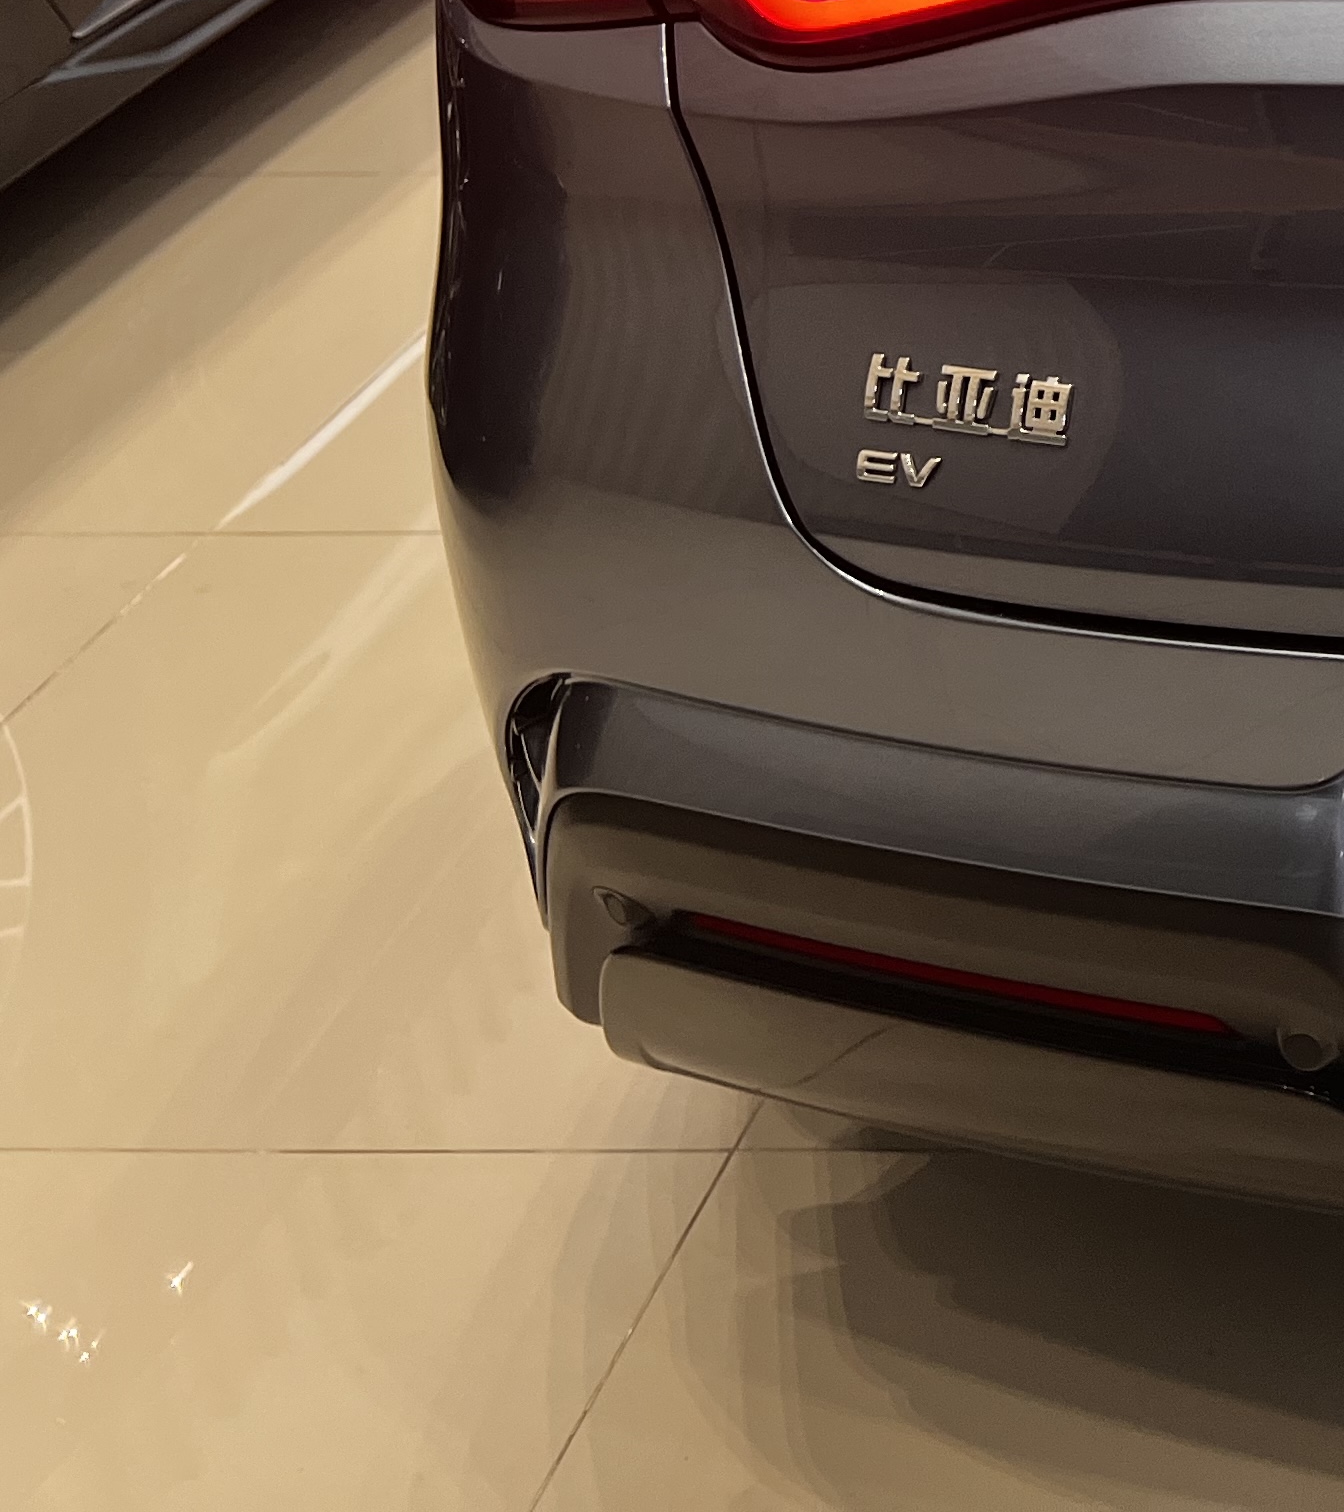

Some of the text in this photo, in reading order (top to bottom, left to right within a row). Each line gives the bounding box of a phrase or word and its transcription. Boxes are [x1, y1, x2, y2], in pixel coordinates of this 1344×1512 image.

[864, 353, 1073, 446] 比亚迪
[856, 449, 943, 488] EV
